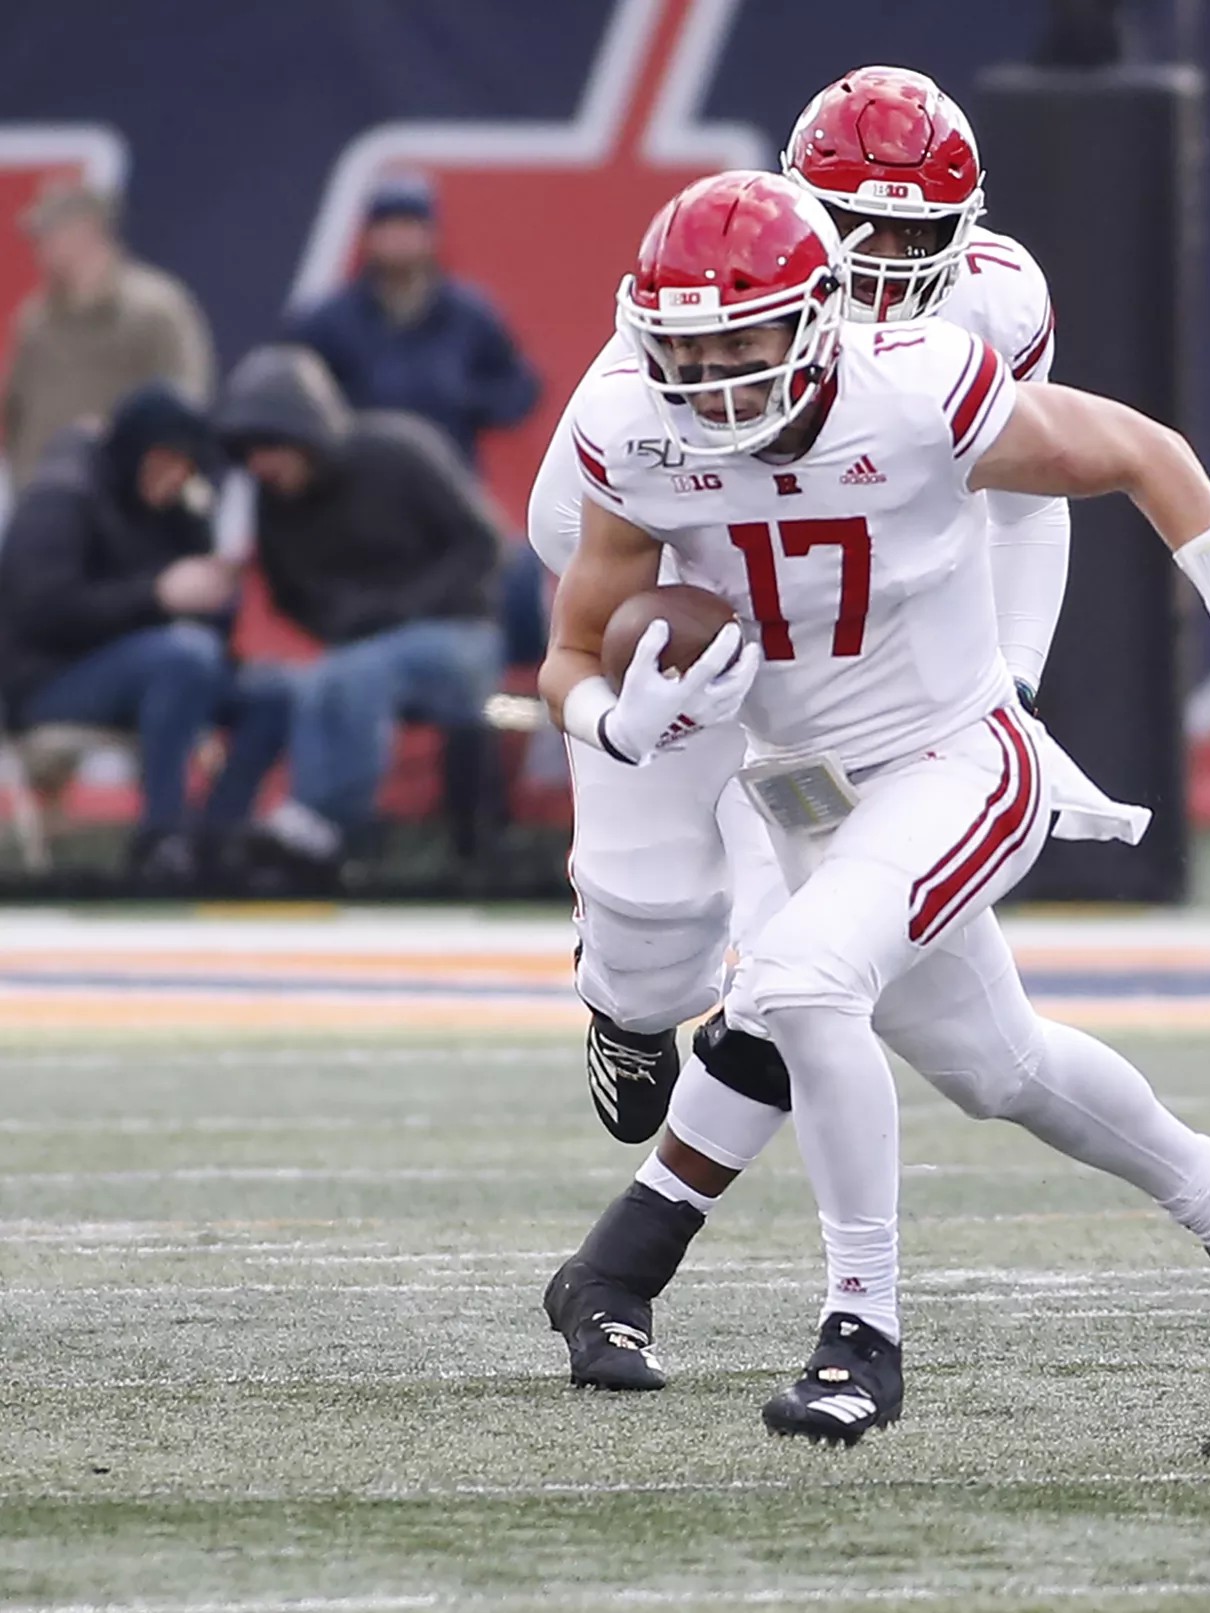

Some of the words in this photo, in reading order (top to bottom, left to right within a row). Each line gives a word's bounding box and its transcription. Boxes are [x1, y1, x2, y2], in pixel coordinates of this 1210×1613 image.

[624, 437, 688, 469] 150
[773, 473, 802, 496] R
[727, 516, 871, 661] 17
